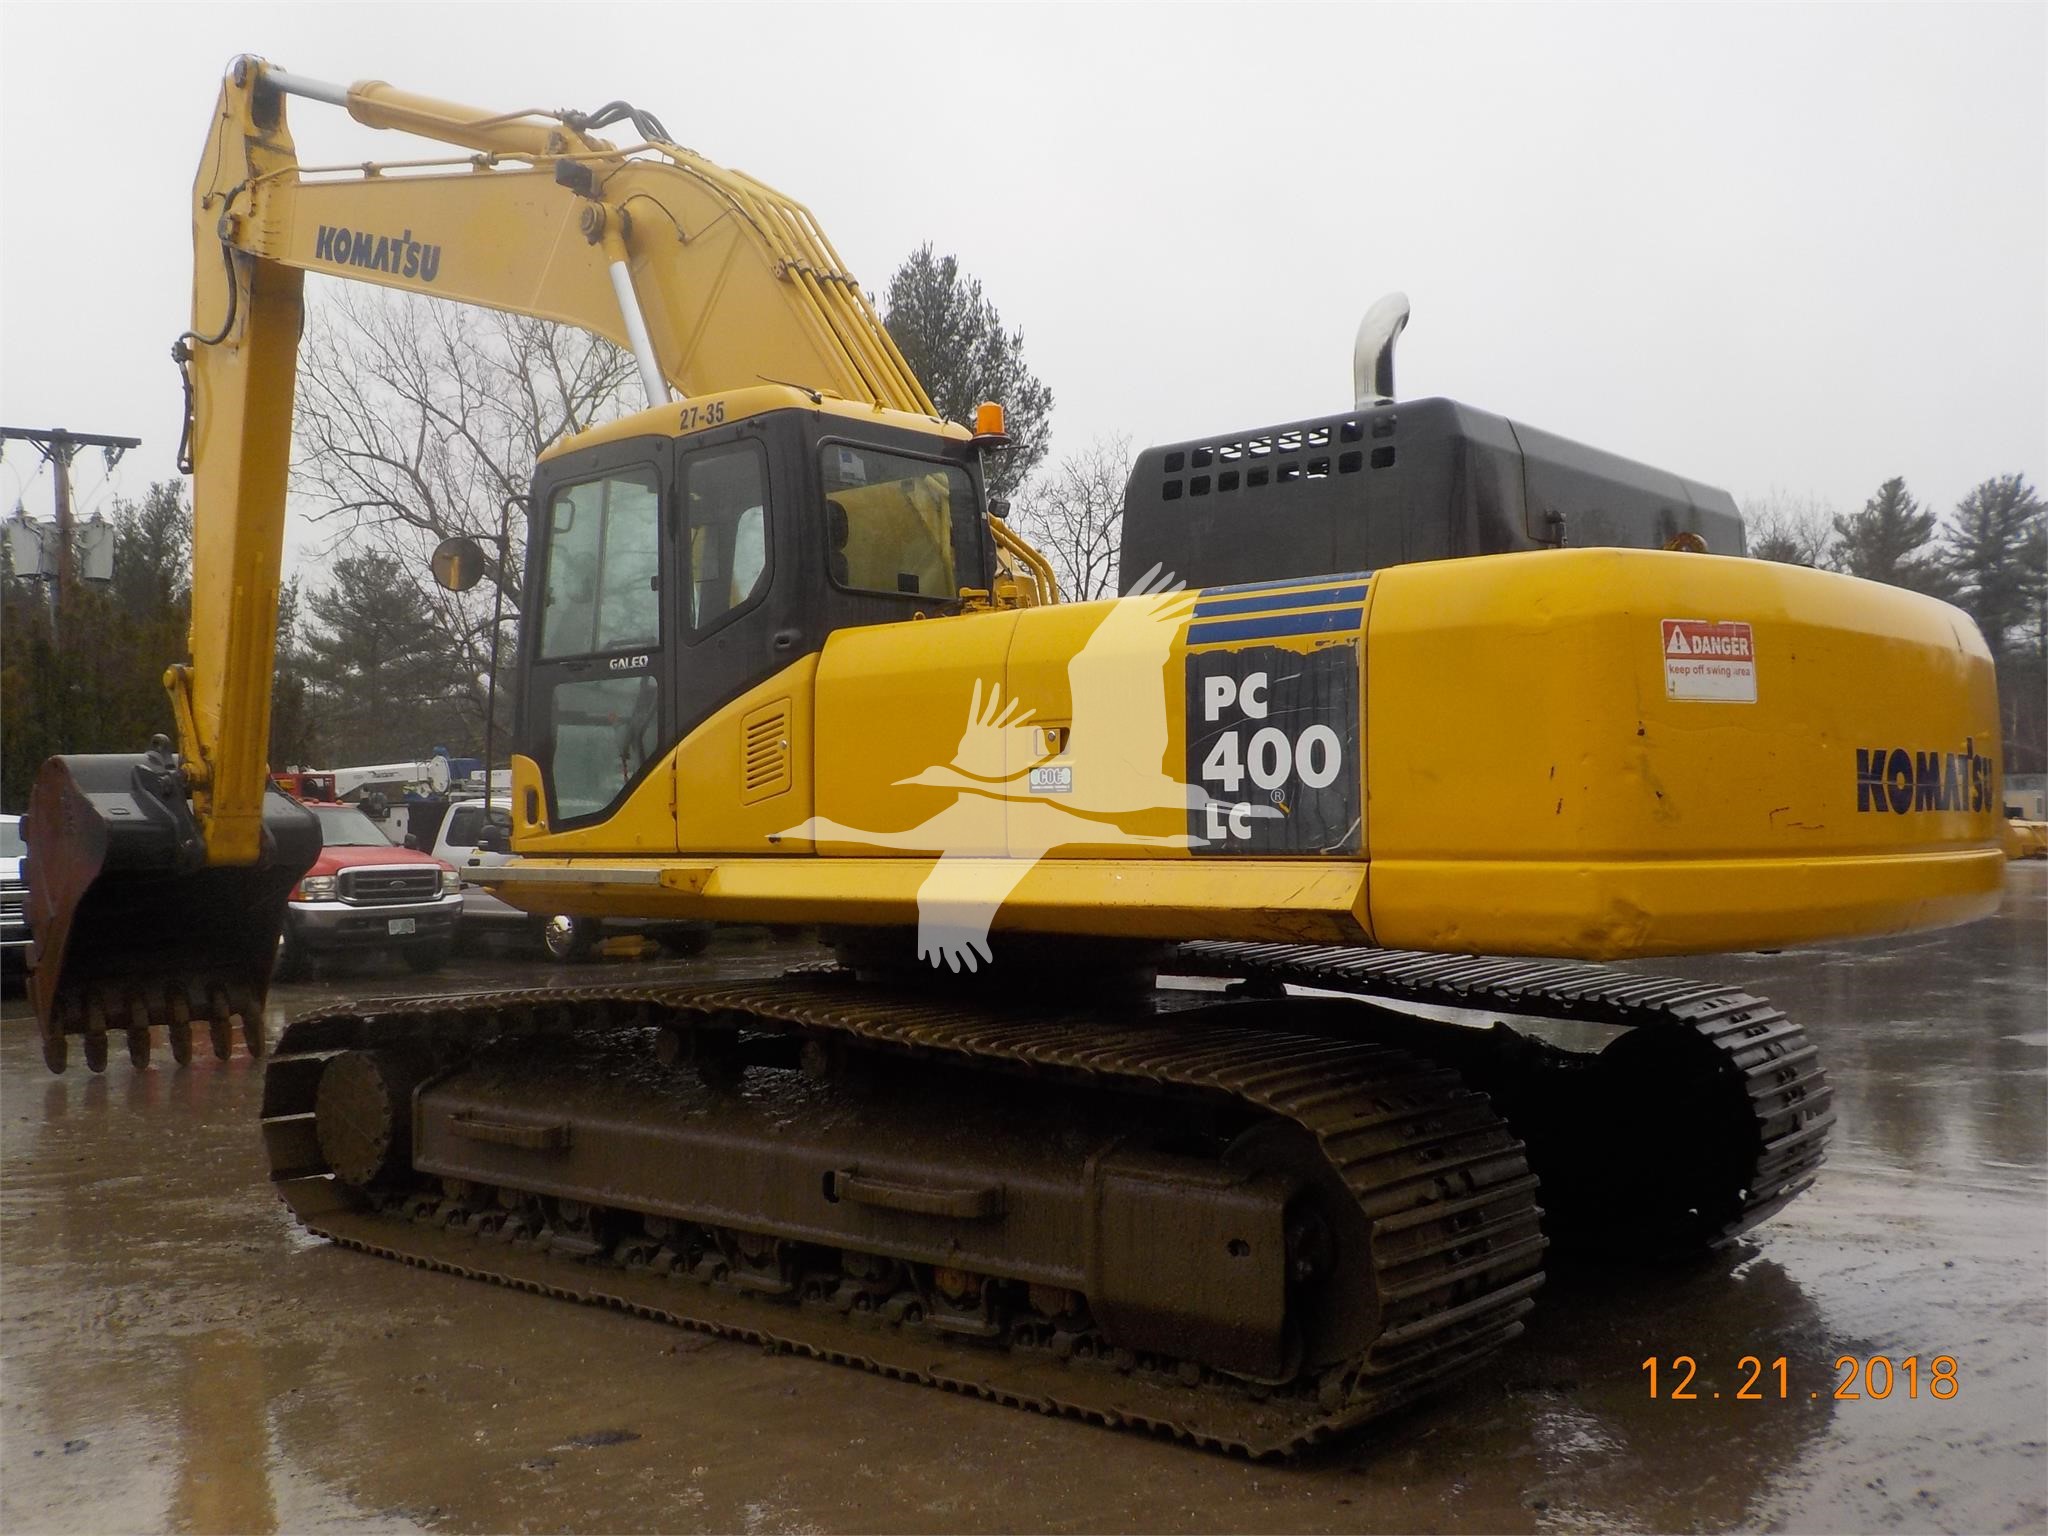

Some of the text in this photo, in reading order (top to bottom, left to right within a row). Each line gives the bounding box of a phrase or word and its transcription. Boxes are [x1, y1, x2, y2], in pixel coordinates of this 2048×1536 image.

[316, 224, 441, 282] KOMATSU
[680, 401, 725, 431] 27-35
[609, 655, 649, 670] GALEO
[1691, 635, 1750, 656] DANGER
[1669, 664, 1691, 676] keep
[1693, 664, 1705, 674] off
[1707, 665, 1731, 678] swing
[1204, 672, 1268, 722] PC
[1202, 724, 1342, 792] 400
[1855, 736, 1993, 815] KOMATSU
[1205, 801, 1252, 840] LC
